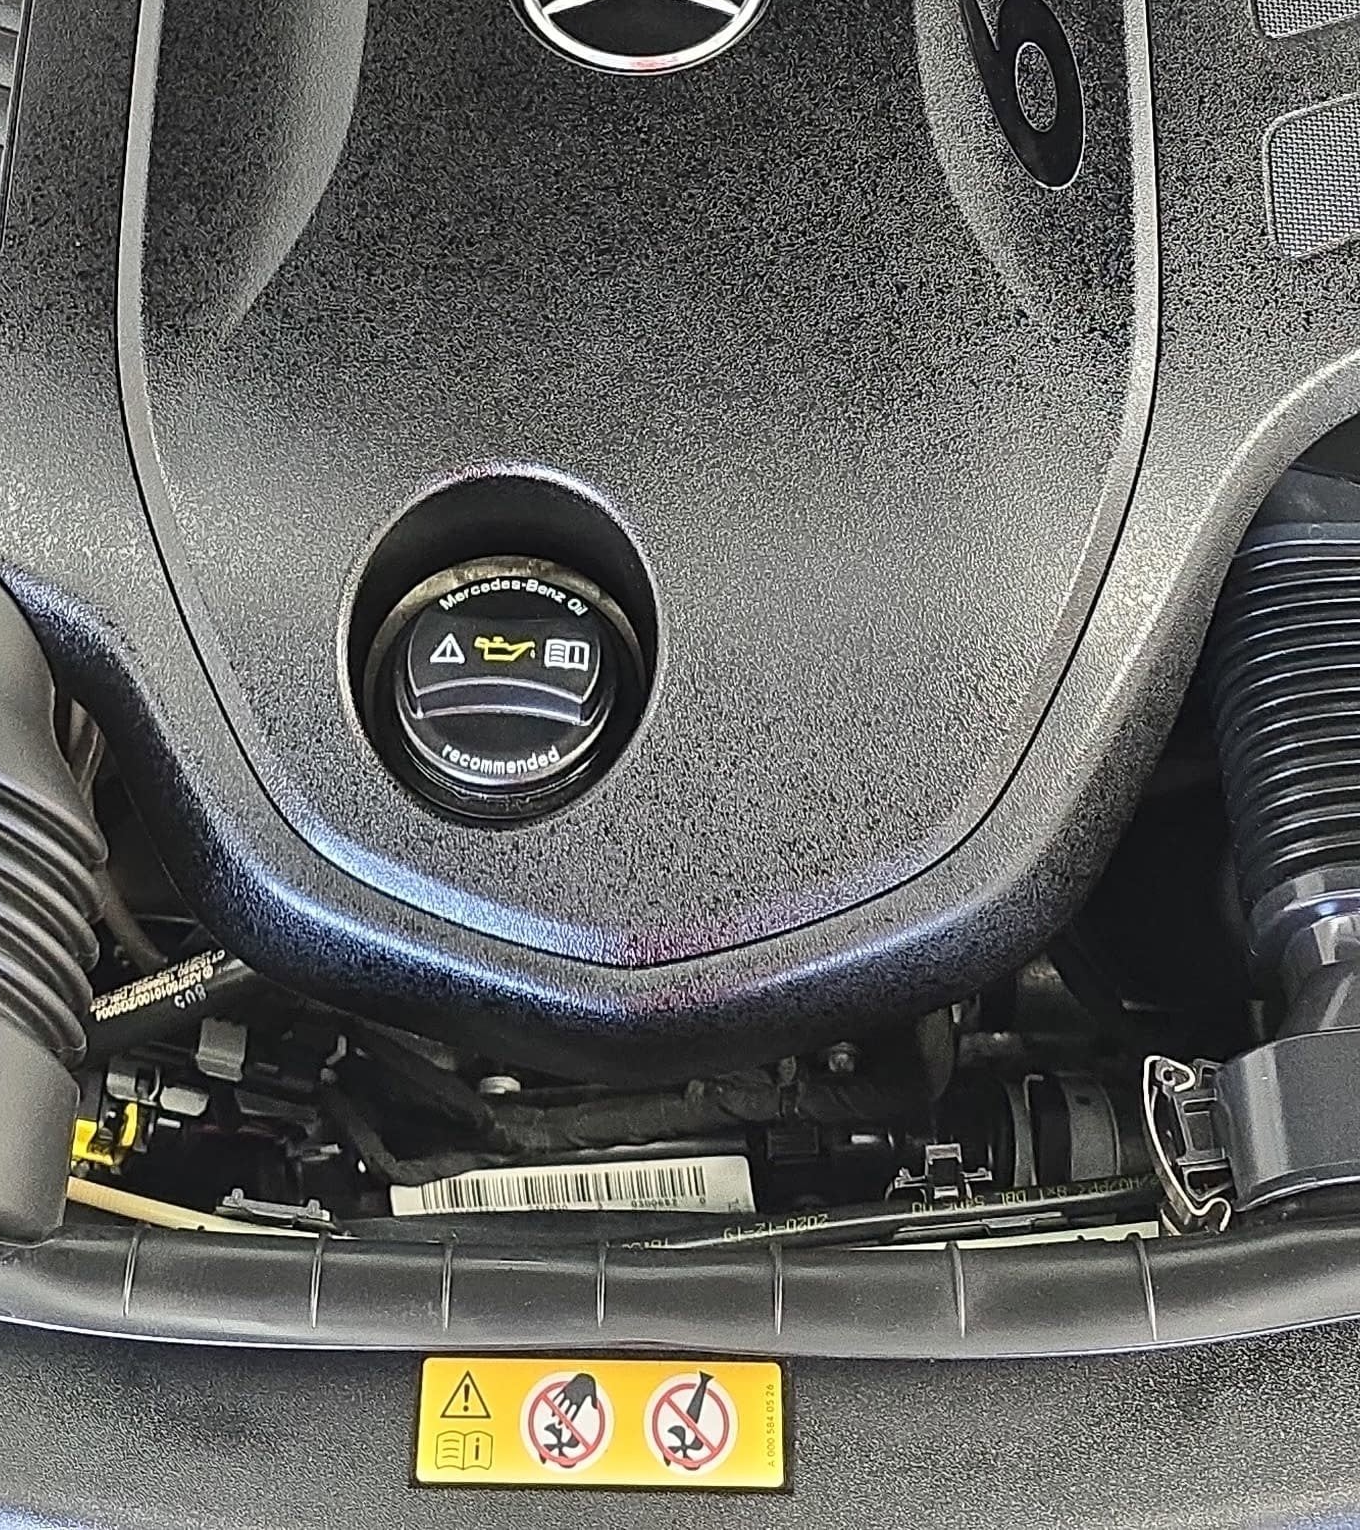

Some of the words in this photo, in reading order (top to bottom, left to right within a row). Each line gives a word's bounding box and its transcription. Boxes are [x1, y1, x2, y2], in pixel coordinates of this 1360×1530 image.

[439, 578, 566, 612] Mercedes-Benz
[567, 598, 589, 617] Oil
[442, 743, 560, 775] recommended
[765, 1383, 775, 1397] 26
[766, 1437, 776, 1458] 000
